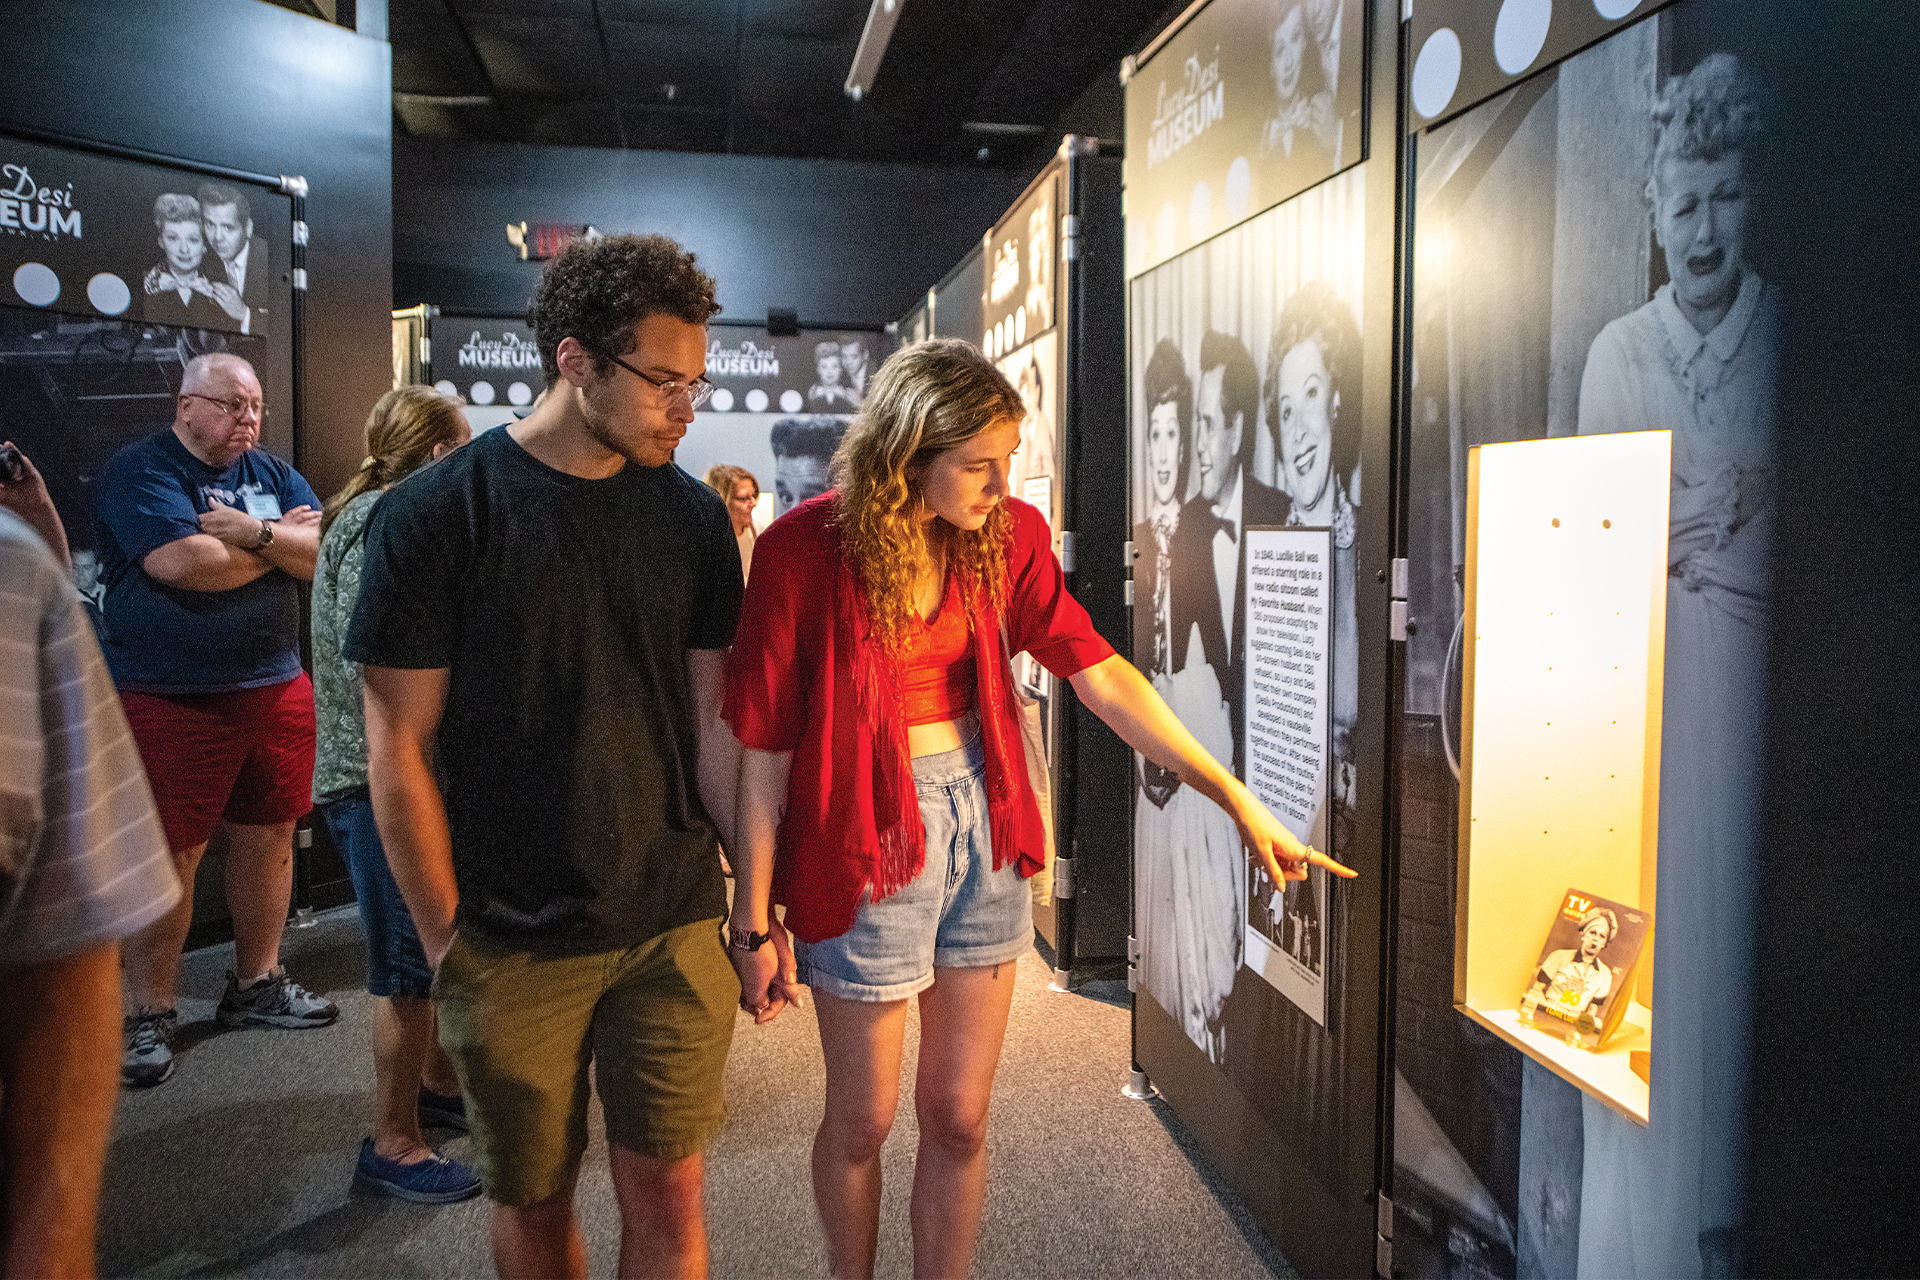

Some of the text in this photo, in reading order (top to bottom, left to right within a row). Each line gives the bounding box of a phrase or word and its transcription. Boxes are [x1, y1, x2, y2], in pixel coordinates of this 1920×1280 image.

[1184, 44, 1220, 106] Desi
[1147, 80, 1224, 171] MUSEUM
[0, 163, 73, 209] Desi
[0, 198, 82, 239] EUM
[463, 330, 502, 350] Lucy
[706, 339, 776, 360] Lucy Desi
[459, 349, 542, 368] MUSEUM
[705, 358, 779, 376] MUSEUM
[1276, 550, 1294, 561] Lucille
[1295, 550, 1305, 562] Ball
[1307, 554, 1318, 562] was
[1252, 564, 1270, 576] offered
[1276, 566, 1297, 581] starring
[1298, 568, 1310, 579] role
[1311, 568, 1317, 580] in
[1318, 571, 1322, 580] a
[1254, 582, 1318, 597] new radio sitcom called
[1259, 597, 1279, 609] Favorite
[1280, 600, 1306, 612] Husband.
[1308, 604, 1322, 615] When
[1264, 614, 1285, 625] proposed
[1286, 618, 1308, 631] adapting
[1309, 620, 1318, 630] the
[1256, 626, 1268, 635] show
[1302, 634, 1315, 647] Lucy
[1251, 640, 1322, 660] suggested casting Desi as her
[1256, 654, 1280, 666] on-screen
[1281, 660, 1303, 672] husband.
[1274, 673, 1280, 681] so
[1281, 672, 1292, 686] Lucy
[1294, 678, 1303, 687] and
[1304, 679, 1316, 690] Desi
[1253, 679, 1317, 708] formed their own company
[1272, 699, 1302, 718] Productions)
[1303, 710, 1313, 720] and
[1258, 710, 1281, 724] developed
[1286, 721, 1312, 734] vaudeville
[1250, 721, 1320, 753] routine which they performed
[1250, 734, 1269, 747] together
[1270, 742, 1276, 750] on
[1289, 748, 1301, 760] After
[1302, 754, 1320, 771] seeing
[1261, 753, 1280, 767] success
[1281, 760, 1286, 768] of
[1287, 762, 1295, 773] the
[1263, 768, 1285, 783] approved
[1286, 776, 1294, 787] the
[1295, 781, 1306, 792] plan
[1307, 784, 1315, 795] for
[1264, 782, 1273, 792] and
[1274, 784, 1284, 797] Desi
[1284, 790, 1290, 800] to
[1291, 794, 1310, 808] co-star
[1310, 801, 1316, 812] in
[1260, 793, 1270, 804] their
[1271, 799, 1281, 810] own
[1288, 807, 1308, 823] sitcom.
[1568, 894, 1591, 912] TV
[1560, 990, 1581, 1006] 50
[1550, 1007, 1564, 1019] LOVE
